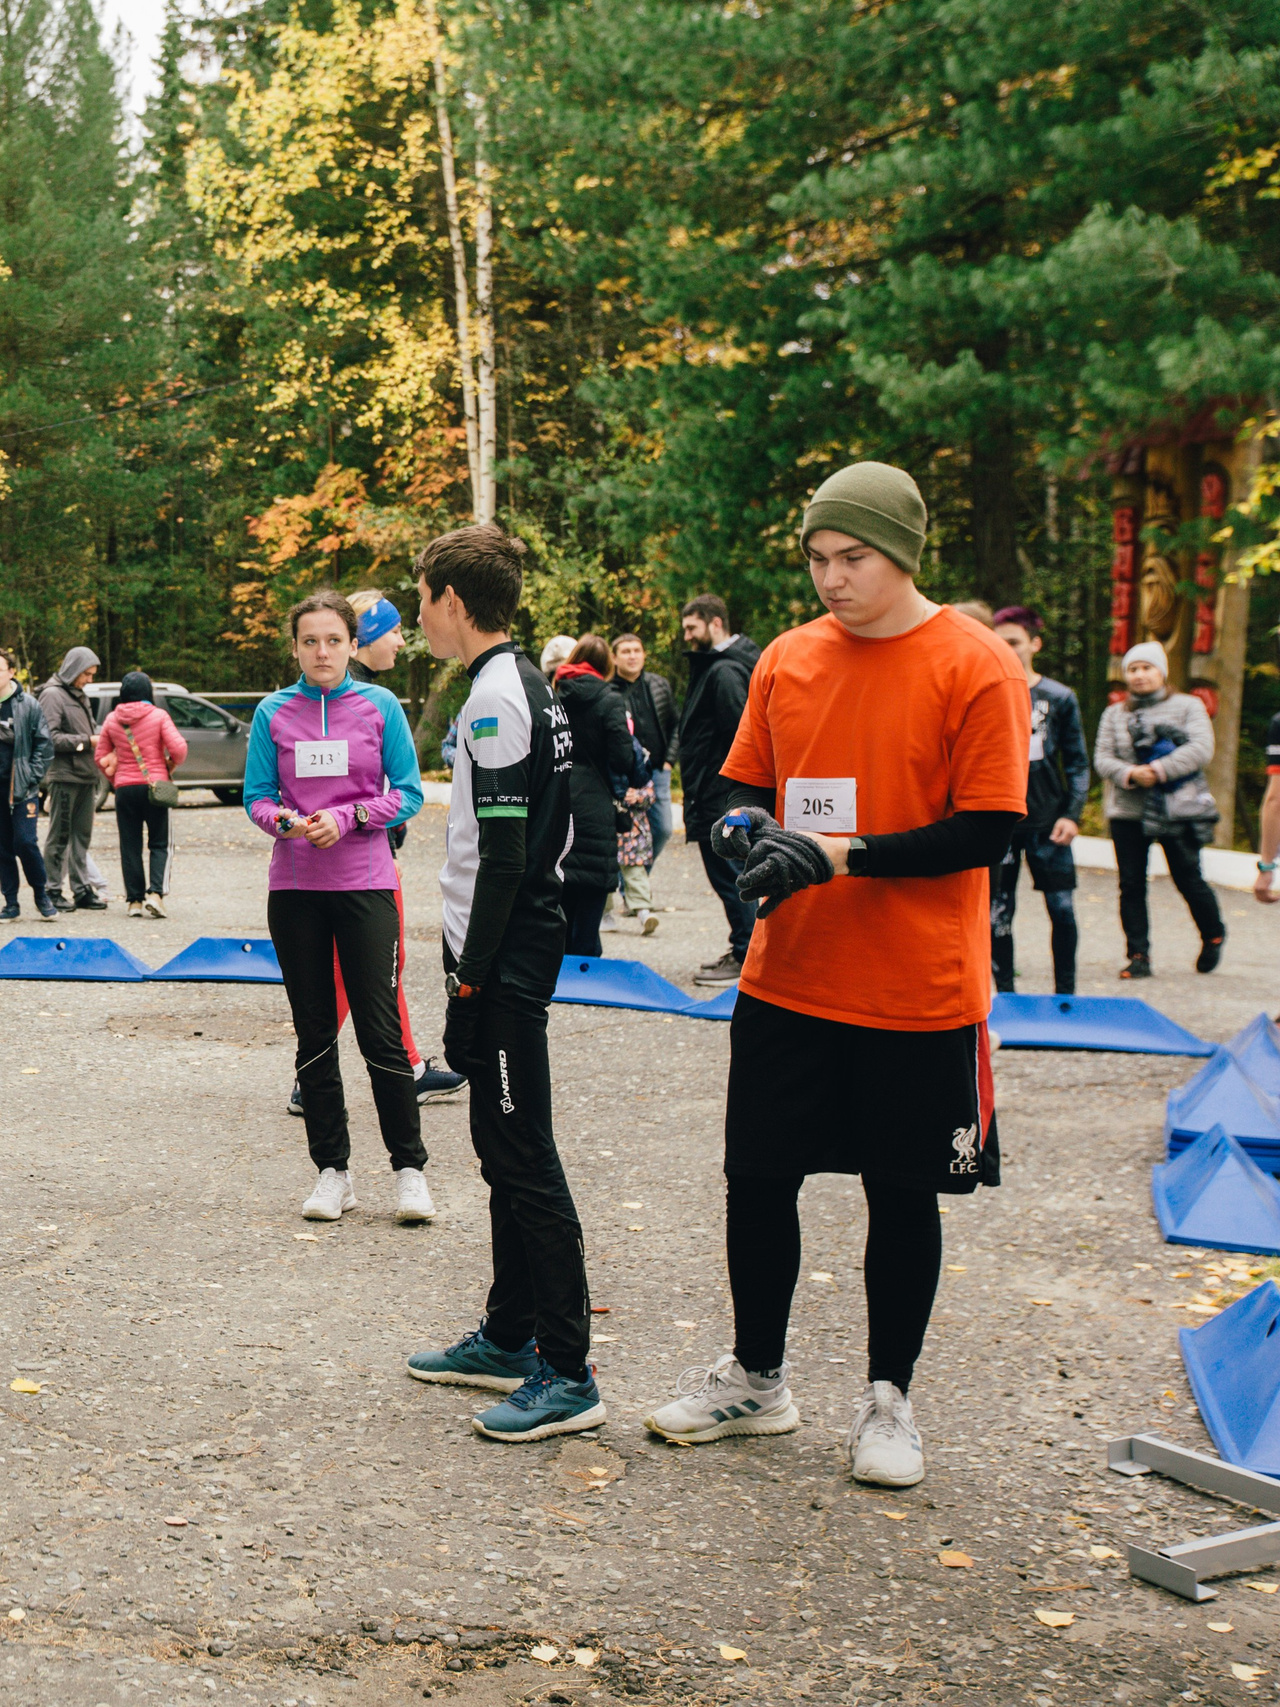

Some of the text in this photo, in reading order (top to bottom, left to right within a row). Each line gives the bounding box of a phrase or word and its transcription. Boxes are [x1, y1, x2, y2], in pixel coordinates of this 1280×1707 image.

[310, 753, 334, 766] 213
[802, 798, 834, 816] 205
[499, 1049, 510, 1097] NORD
